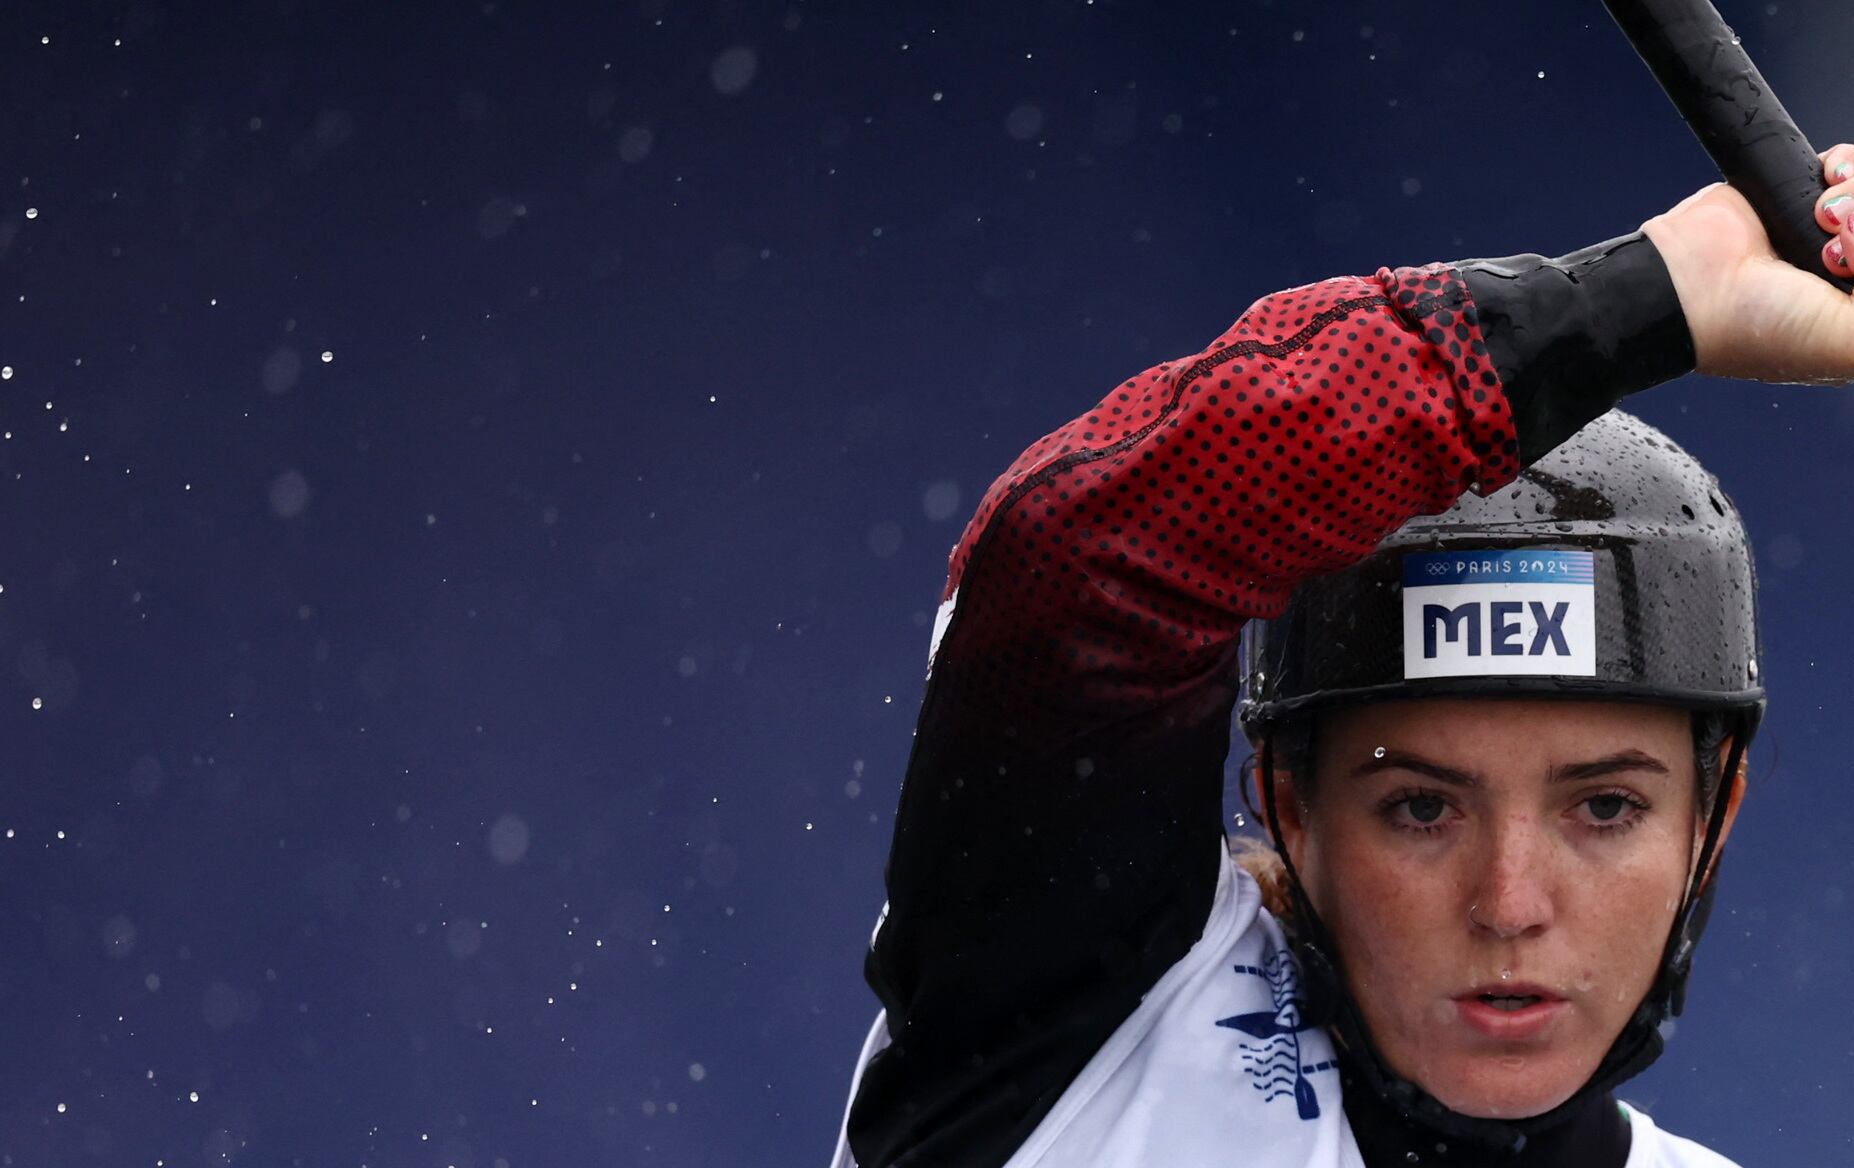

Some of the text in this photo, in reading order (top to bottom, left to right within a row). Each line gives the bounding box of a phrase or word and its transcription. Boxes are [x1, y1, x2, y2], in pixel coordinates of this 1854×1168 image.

[1456, 560, 1568, 573] PARIS 2024
[1423, 601, 1573, 659] MEX
